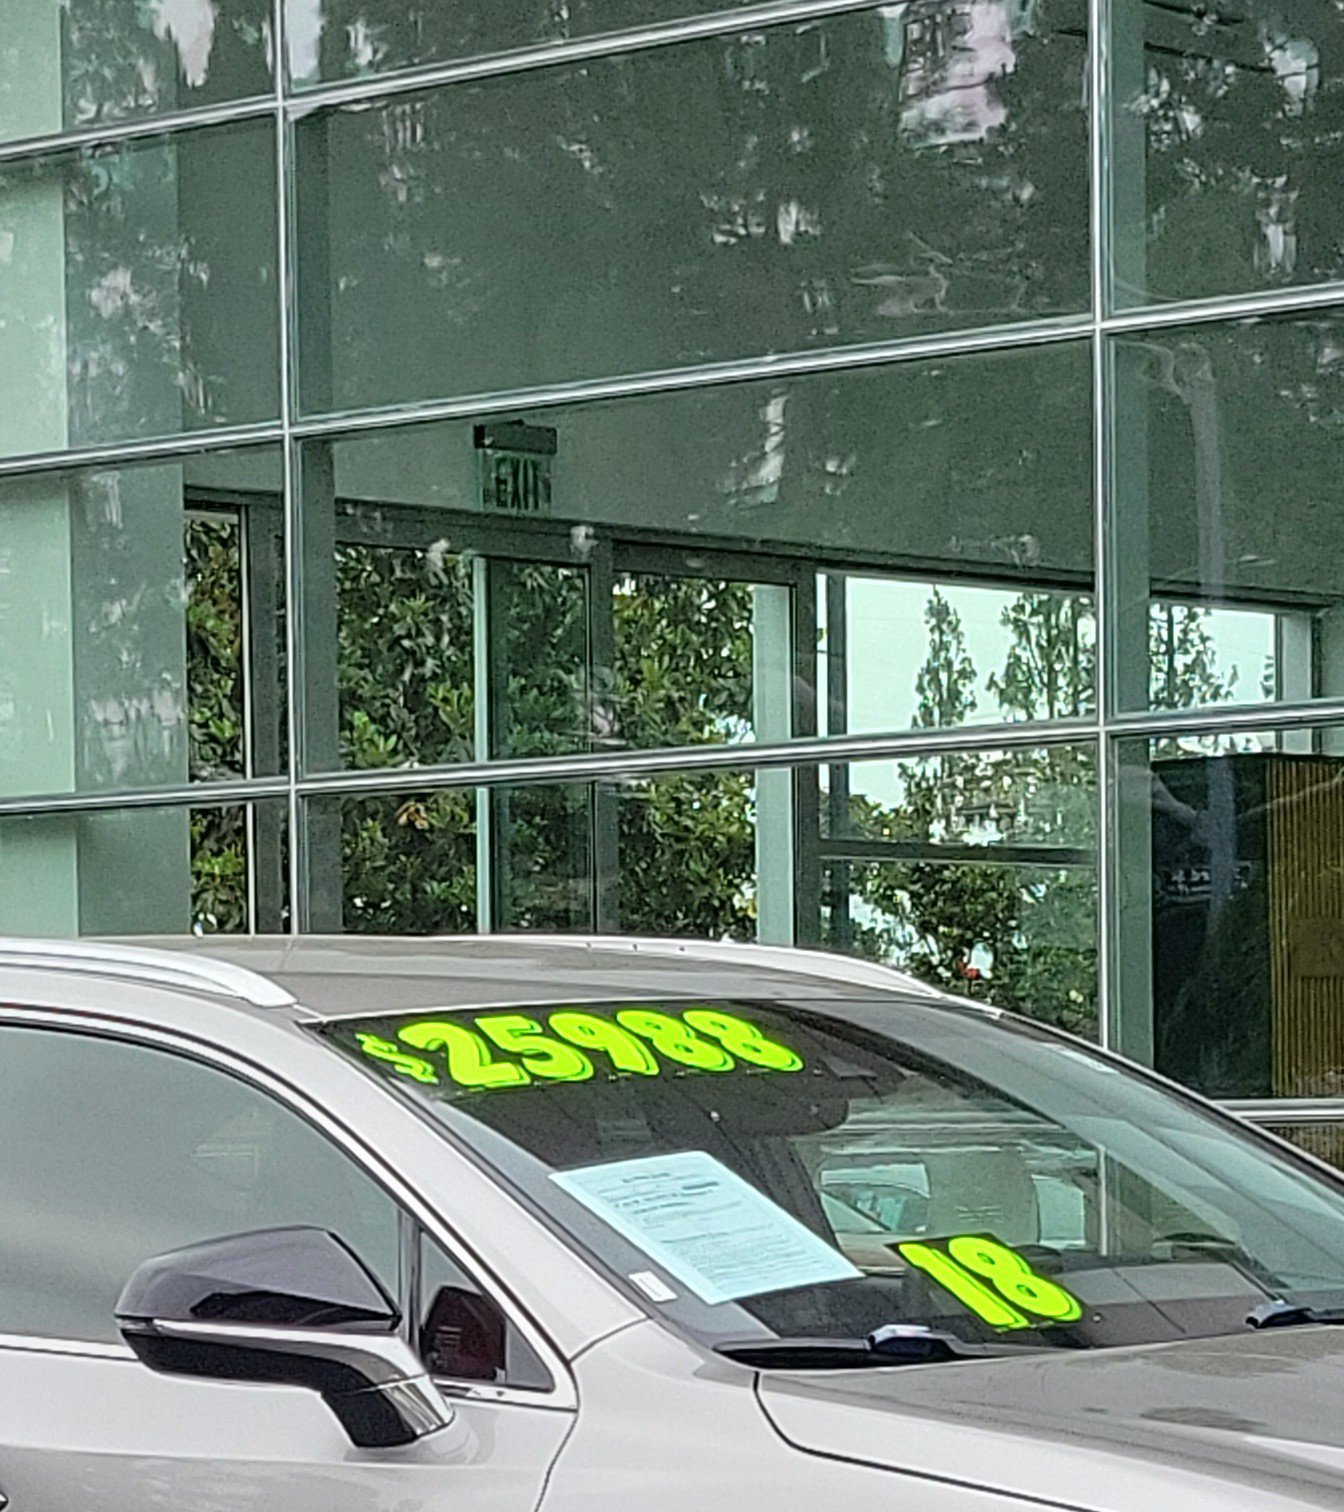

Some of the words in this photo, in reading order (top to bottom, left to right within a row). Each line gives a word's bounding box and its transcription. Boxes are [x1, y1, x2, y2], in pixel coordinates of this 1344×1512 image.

[495, 456, 541, 510] EXIT
[356, 1010, 804, 1088] $25988
[898, 1237, 1082, 1328] 18
